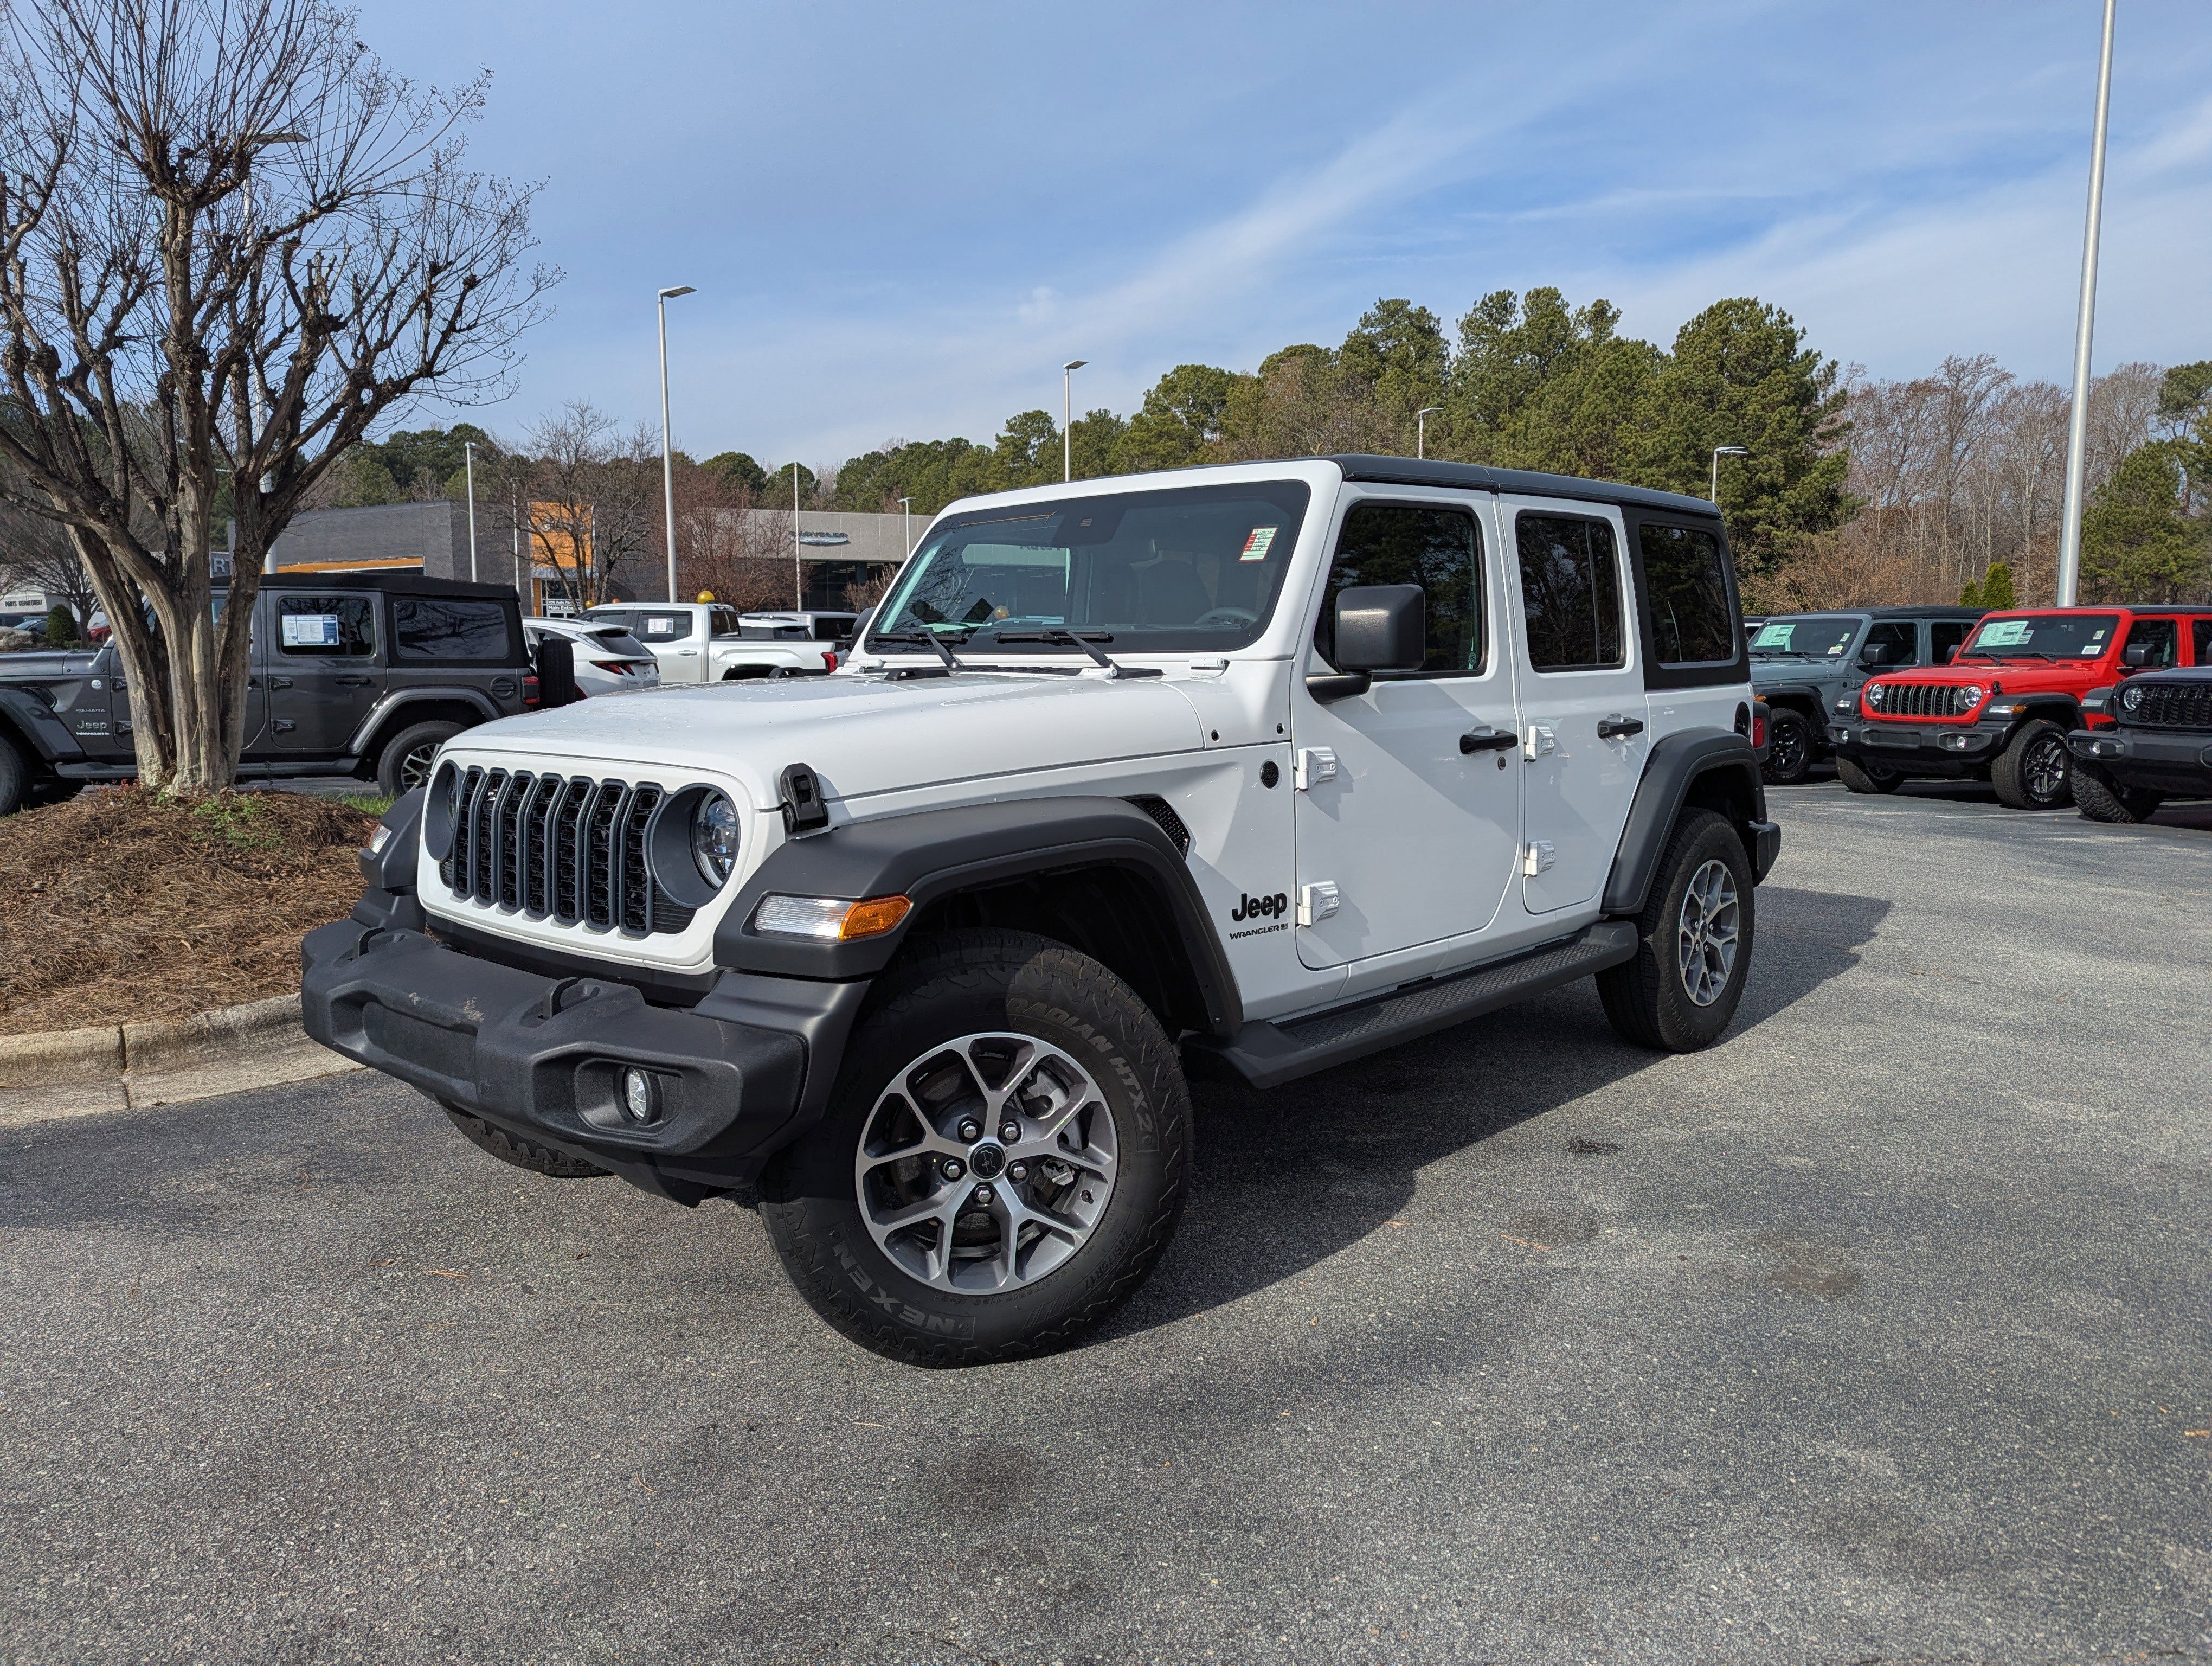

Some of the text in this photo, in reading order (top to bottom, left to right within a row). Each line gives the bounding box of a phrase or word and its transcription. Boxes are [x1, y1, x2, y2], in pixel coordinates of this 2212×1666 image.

[76, 720, 107, 731] Jeep
[1232, 893, 1288, 922] Jeep
[1229, 925, 1279, 940] WRANGLER
[983, 997, 1114, 1053] ROADIAN
[1108, 1056, 1154, 1133] HTX2
[1083, 1228, 1133, 1290] 245/75R17
[832, 1241, 955, 1334] NEXEN
